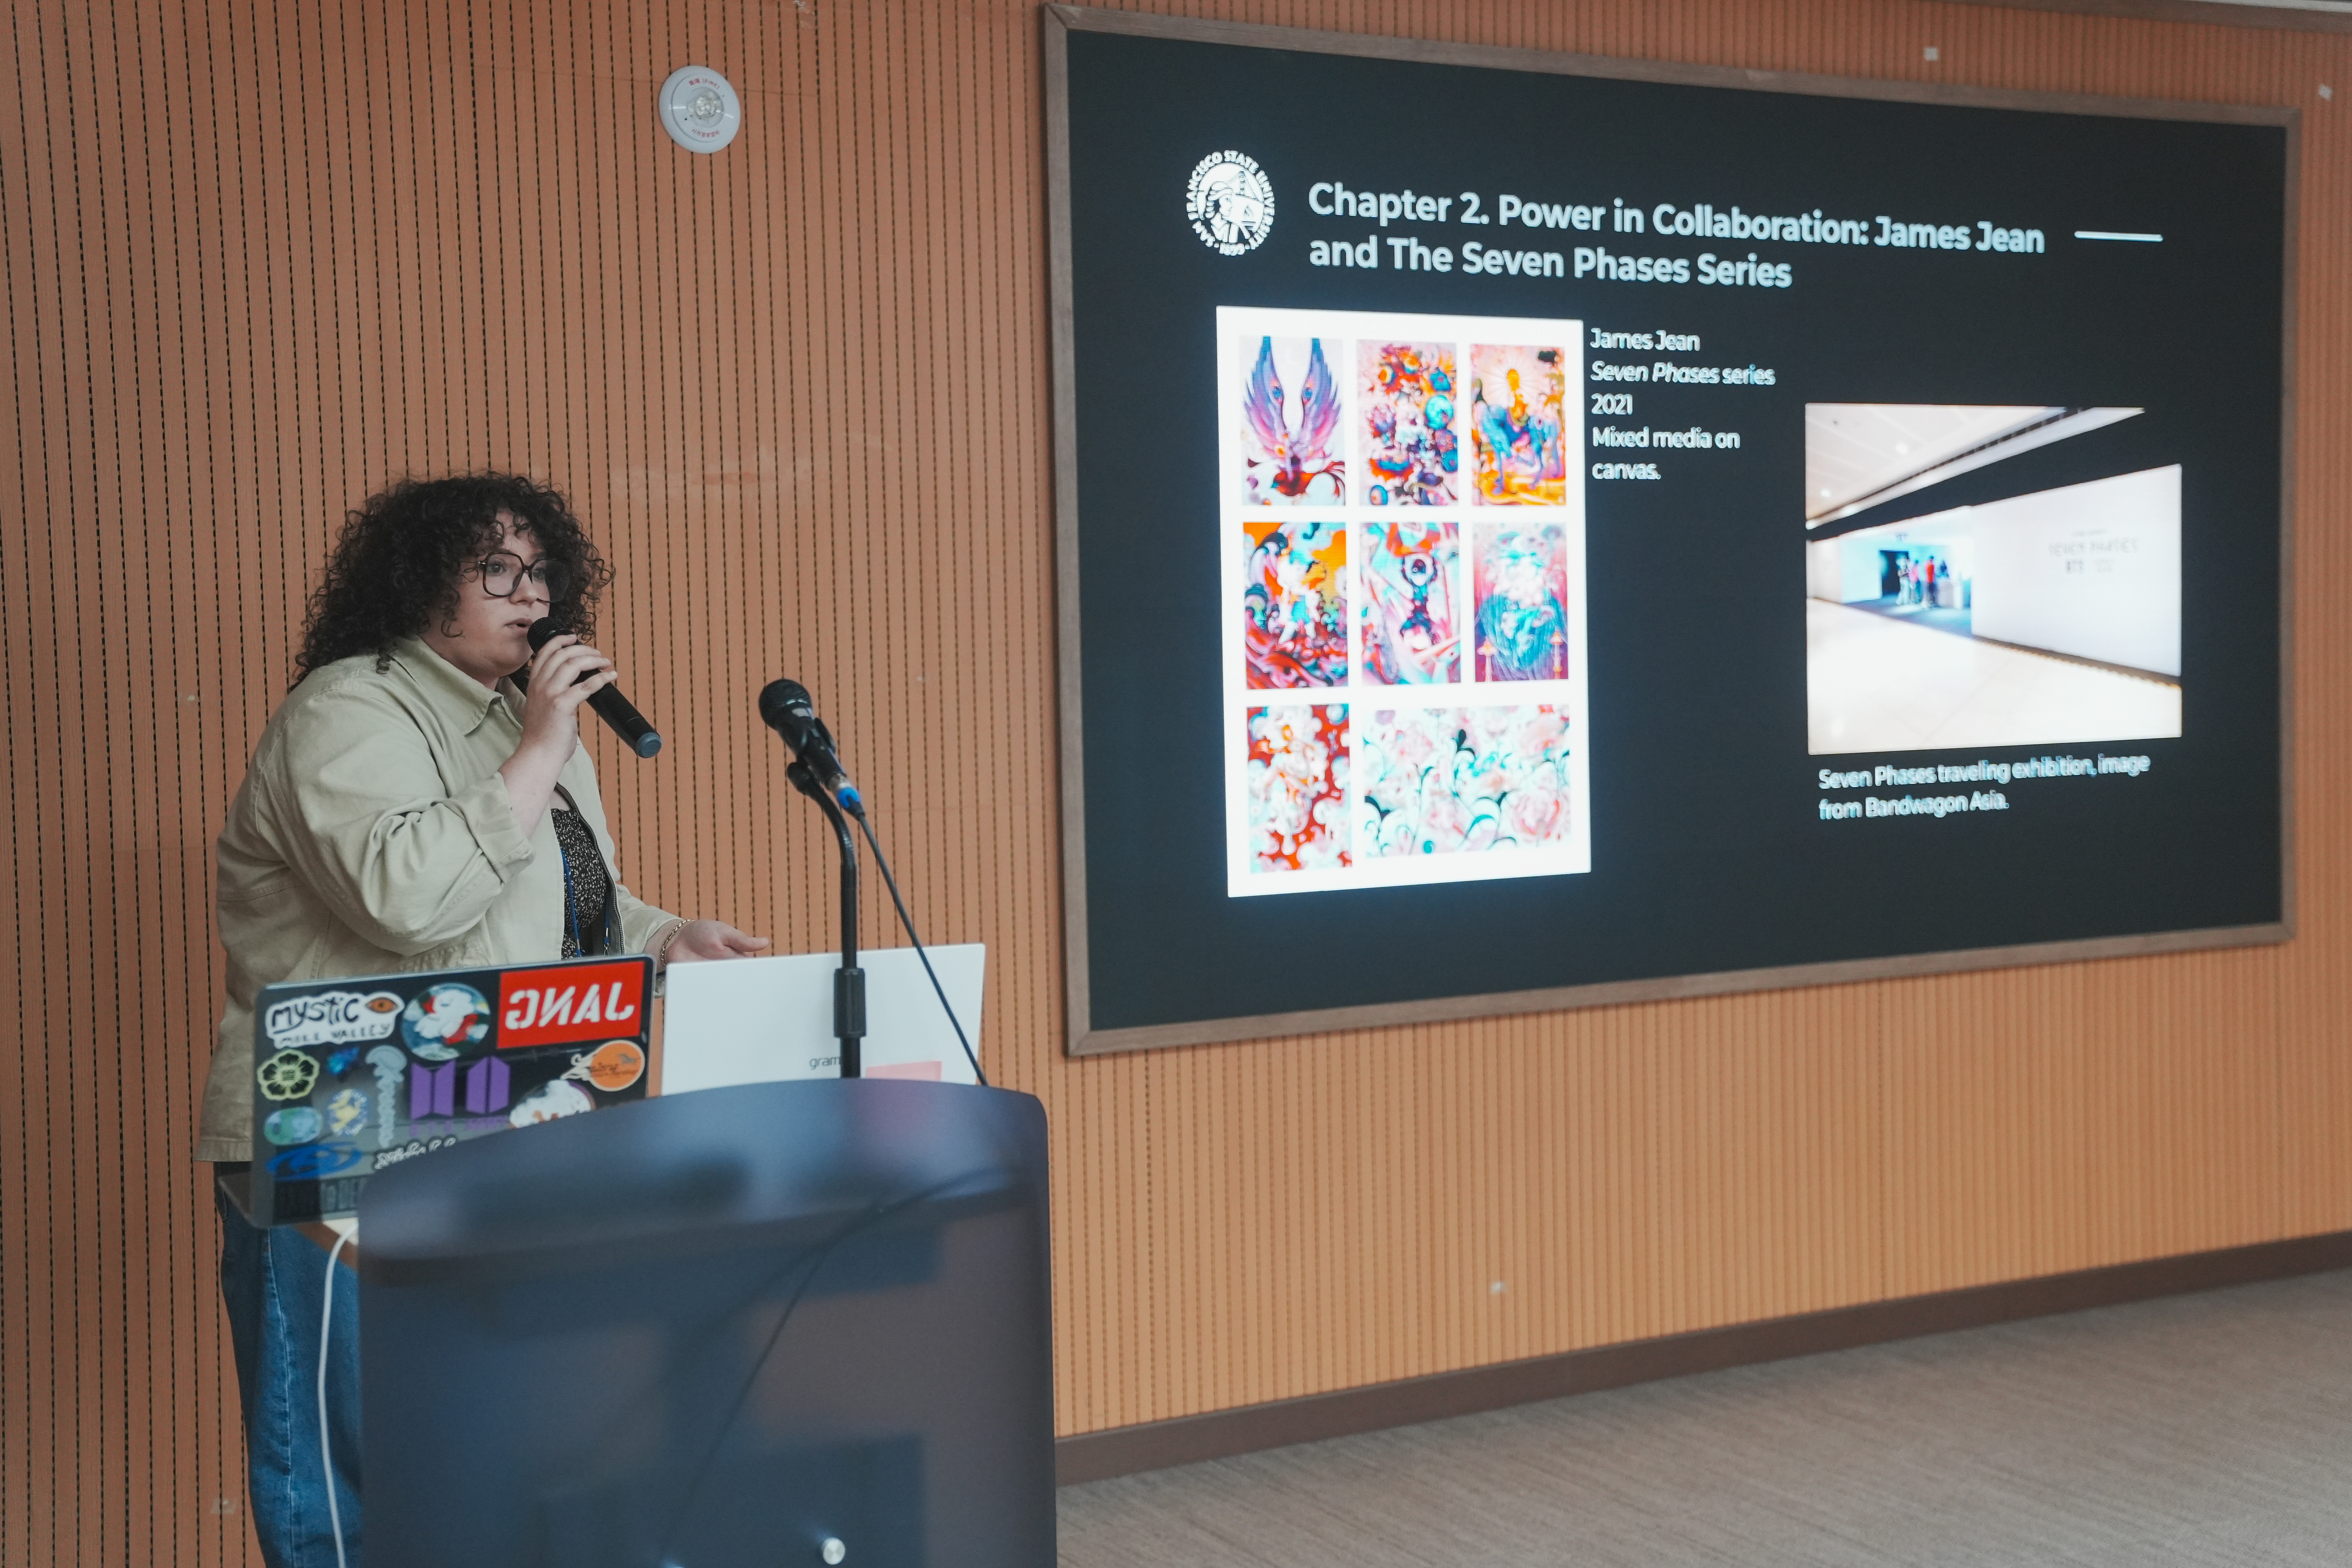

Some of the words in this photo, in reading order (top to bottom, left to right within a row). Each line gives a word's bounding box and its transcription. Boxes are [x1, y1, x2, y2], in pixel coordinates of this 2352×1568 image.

[1186, 151, 1223, 220] FRANCISCO
[1224, 150, 1259, 174] STATE
[1308, 181, 1454, 228] Chapter
[1459, 191, 1490, 225] 2.
[1498, 193, 1607, 232] Power
[1613, 197, 1645, 233] in
[1652, 203, 1870, 246] Collaboration:
[1873, 215, 1972, 250] James
[1974, 220, 2045, 254] Jean
[1309, 234, 1379, 269] and
[1385, 236, 1454, 273] The
[1462, 241, 1565, 278] Seven
[1574, 247, 1690, 284] Phases
[1697, 252, 1794, 288] Series
[1589, 327, 1654, 350] James
[1655, 330, 1701, 352] Jean
[1589, 360, 1649, 382] Seven
[1652, 361, 1721, 384] Phases
[1722, 363, 1776, 385] series
[1590, 393, 1633, 415] 2021
[1592, 425, 1650, 448] Mixed
[1653, 426, 1712, 449] media
[1714, 432, 1741, 449] on
[1591, 462, 1662, 480] canvas.
[1818, 768, 1873, 790] Seven
[1874, 764, 1938, 787] Phases
[1937, 760, 2012, 785] traveling
[2012, 754, 2097, 779] exhibition,
[2097, 752, 2151, 777] image
[1818, 798, 1863, 820] from
[1865, 794, 1969, 818] Bandwagon
[1969, 790, 2010, 812] Asia.
[810, 1057, 841, 1070] gram
